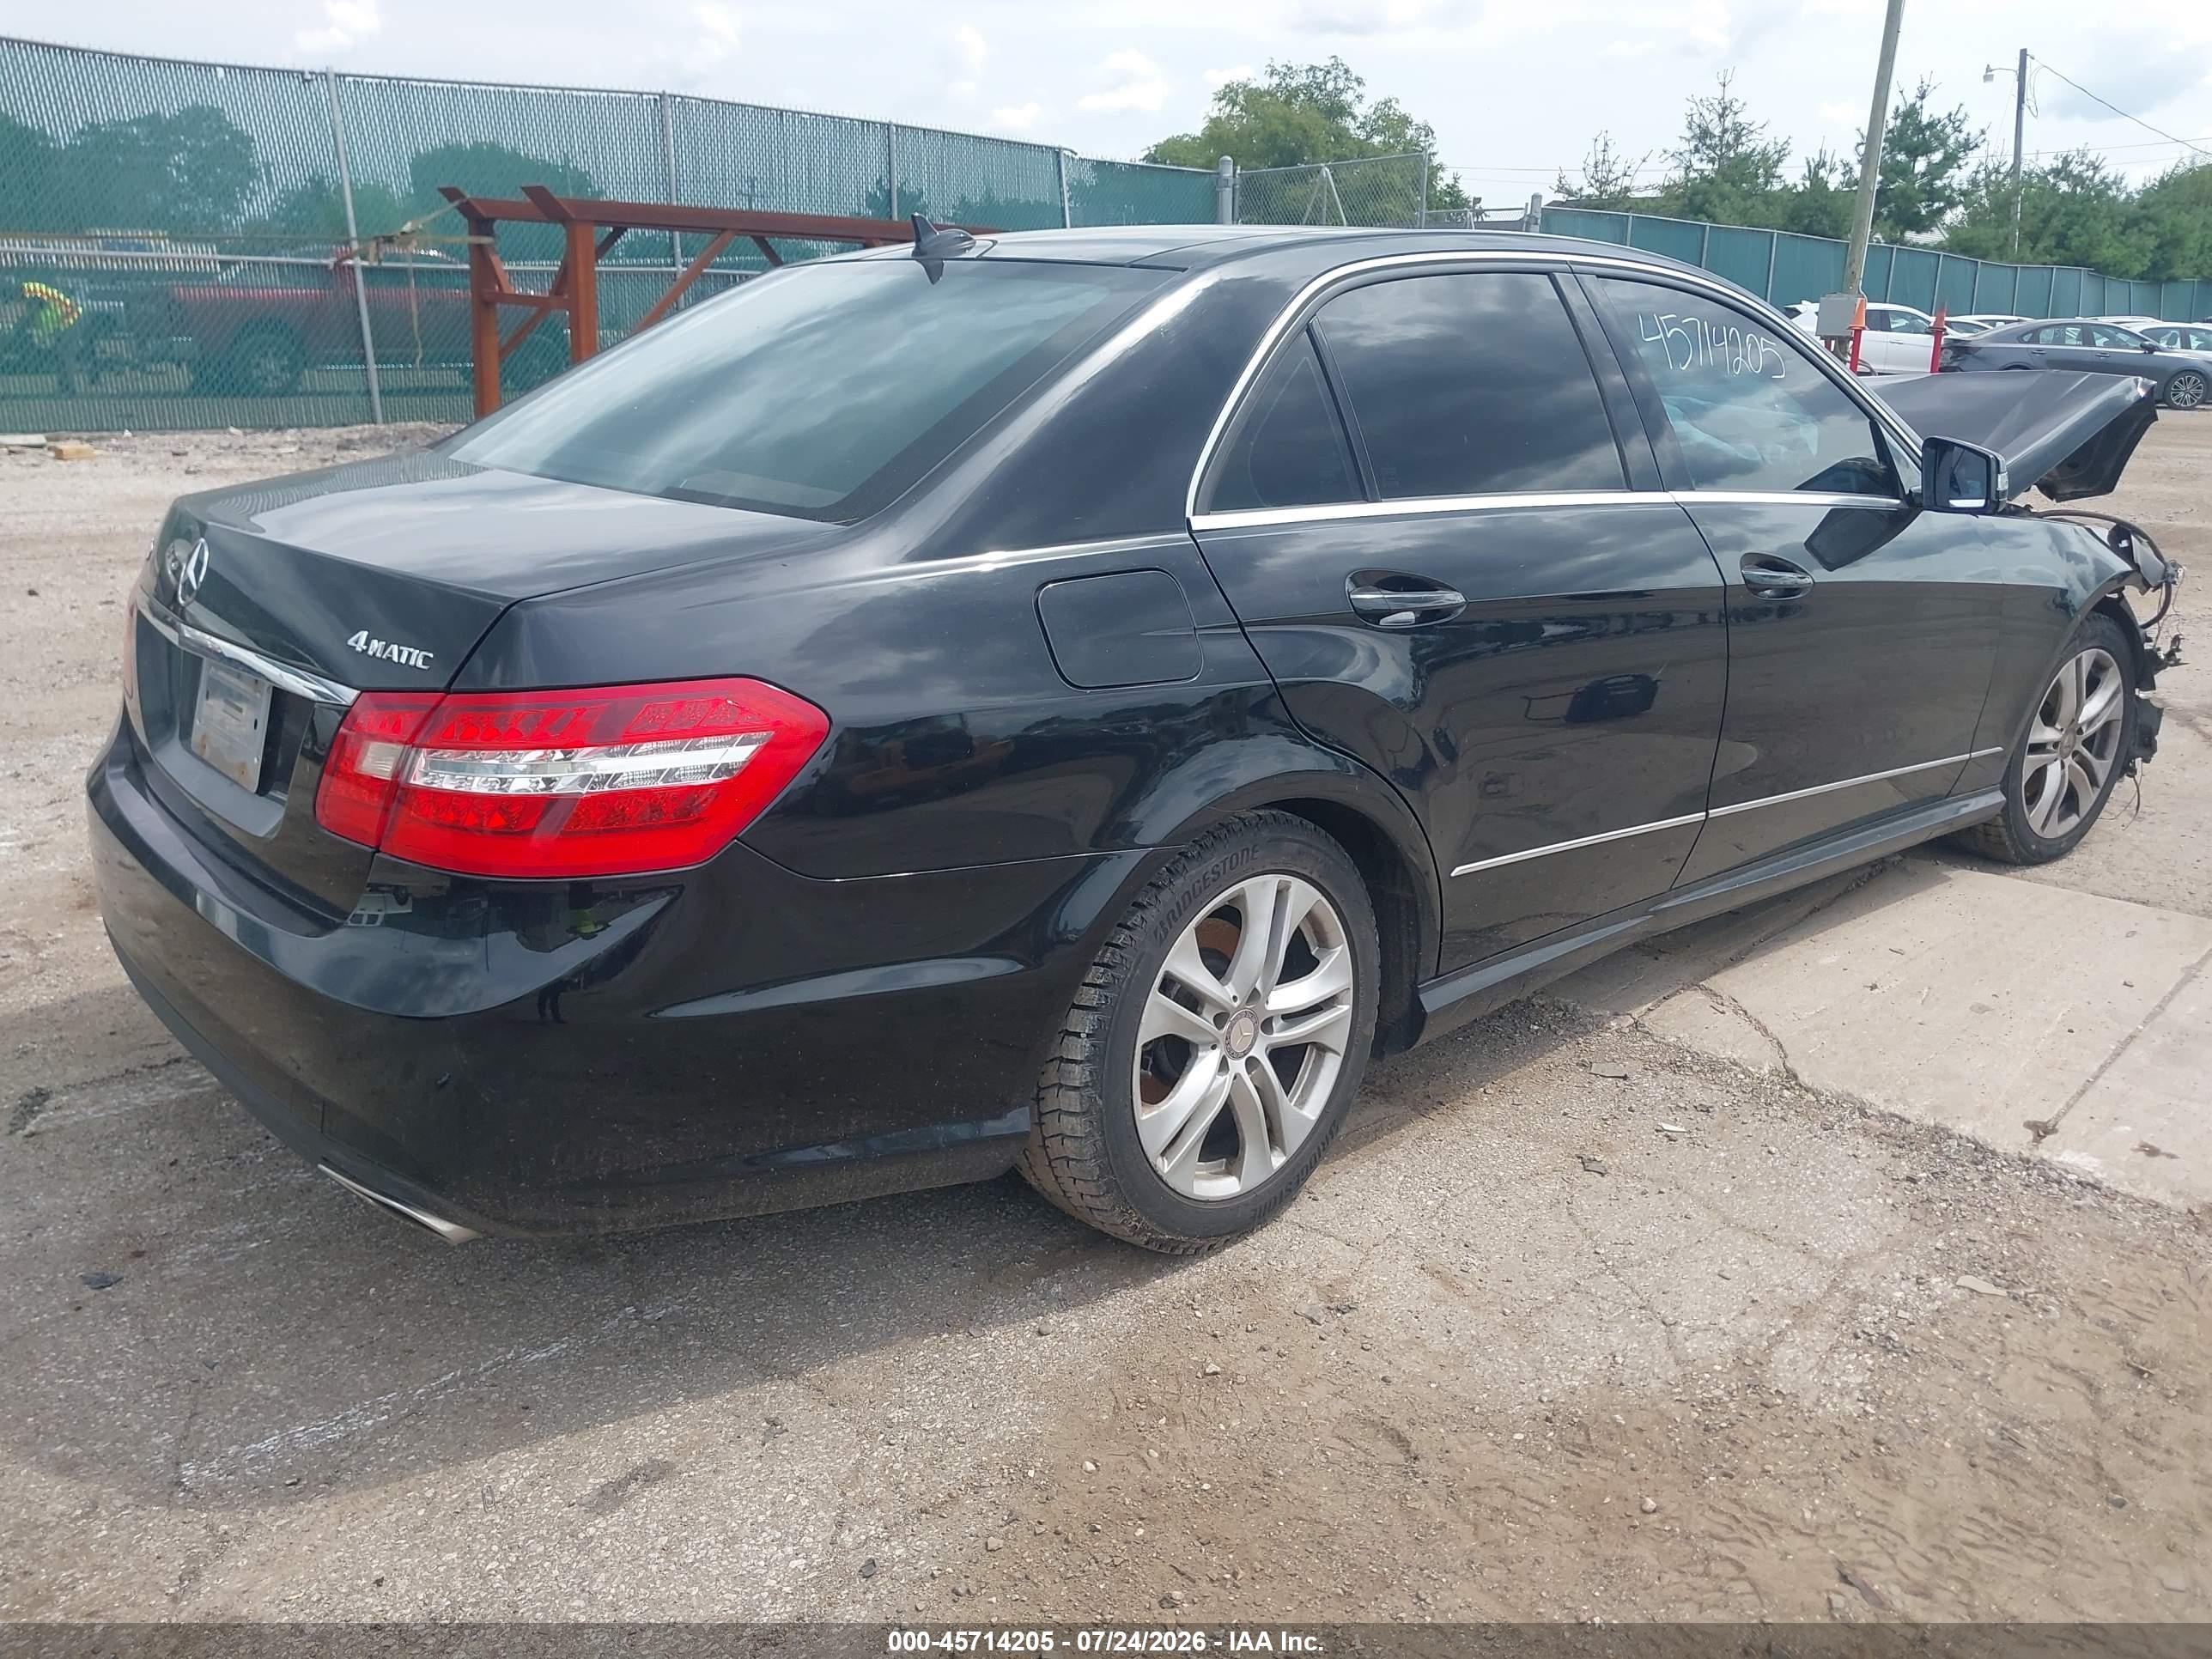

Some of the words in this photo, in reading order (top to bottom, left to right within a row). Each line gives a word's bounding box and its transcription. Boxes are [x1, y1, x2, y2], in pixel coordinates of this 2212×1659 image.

[1638, 313, 1786, 379] 45714205
[347, 629, 434, 671] 4MATIC
[1152, 843, 1261, 947] BRIDGESTONE
